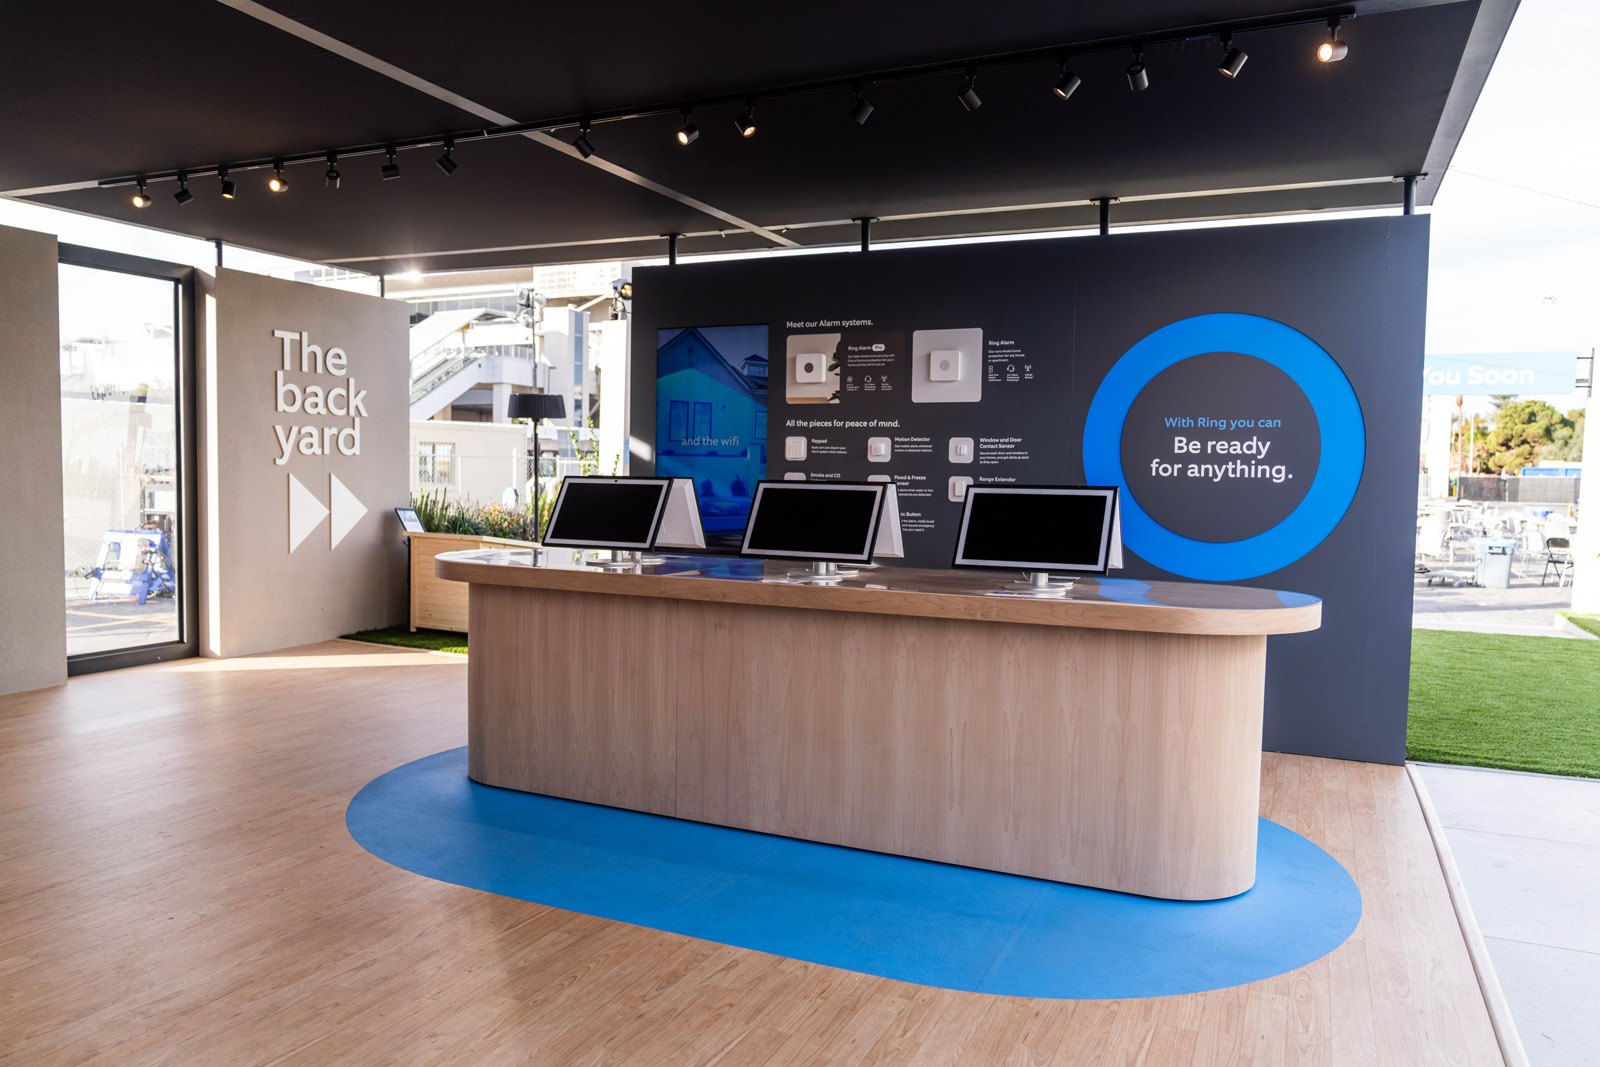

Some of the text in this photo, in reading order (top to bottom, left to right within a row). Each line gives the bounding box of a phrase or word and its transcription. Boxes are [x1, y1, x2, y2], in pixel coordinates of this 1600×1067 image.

[842, 319, 874, 328] systems.
[272, 330, 347, 376] The
[1467, 365, 1535, 385] Soon
[276, 370, 368, 417] back
[809, 420, 832, 428] pieces
[1164, 417, 1281, 430] With Ring you can
[273, 417, 360, 466] yard
[681, 436, 739, 446] and the wifi
[1174, 436, 1270, 459] Be ready
[1151, 459, 1293, 483] for anything.
